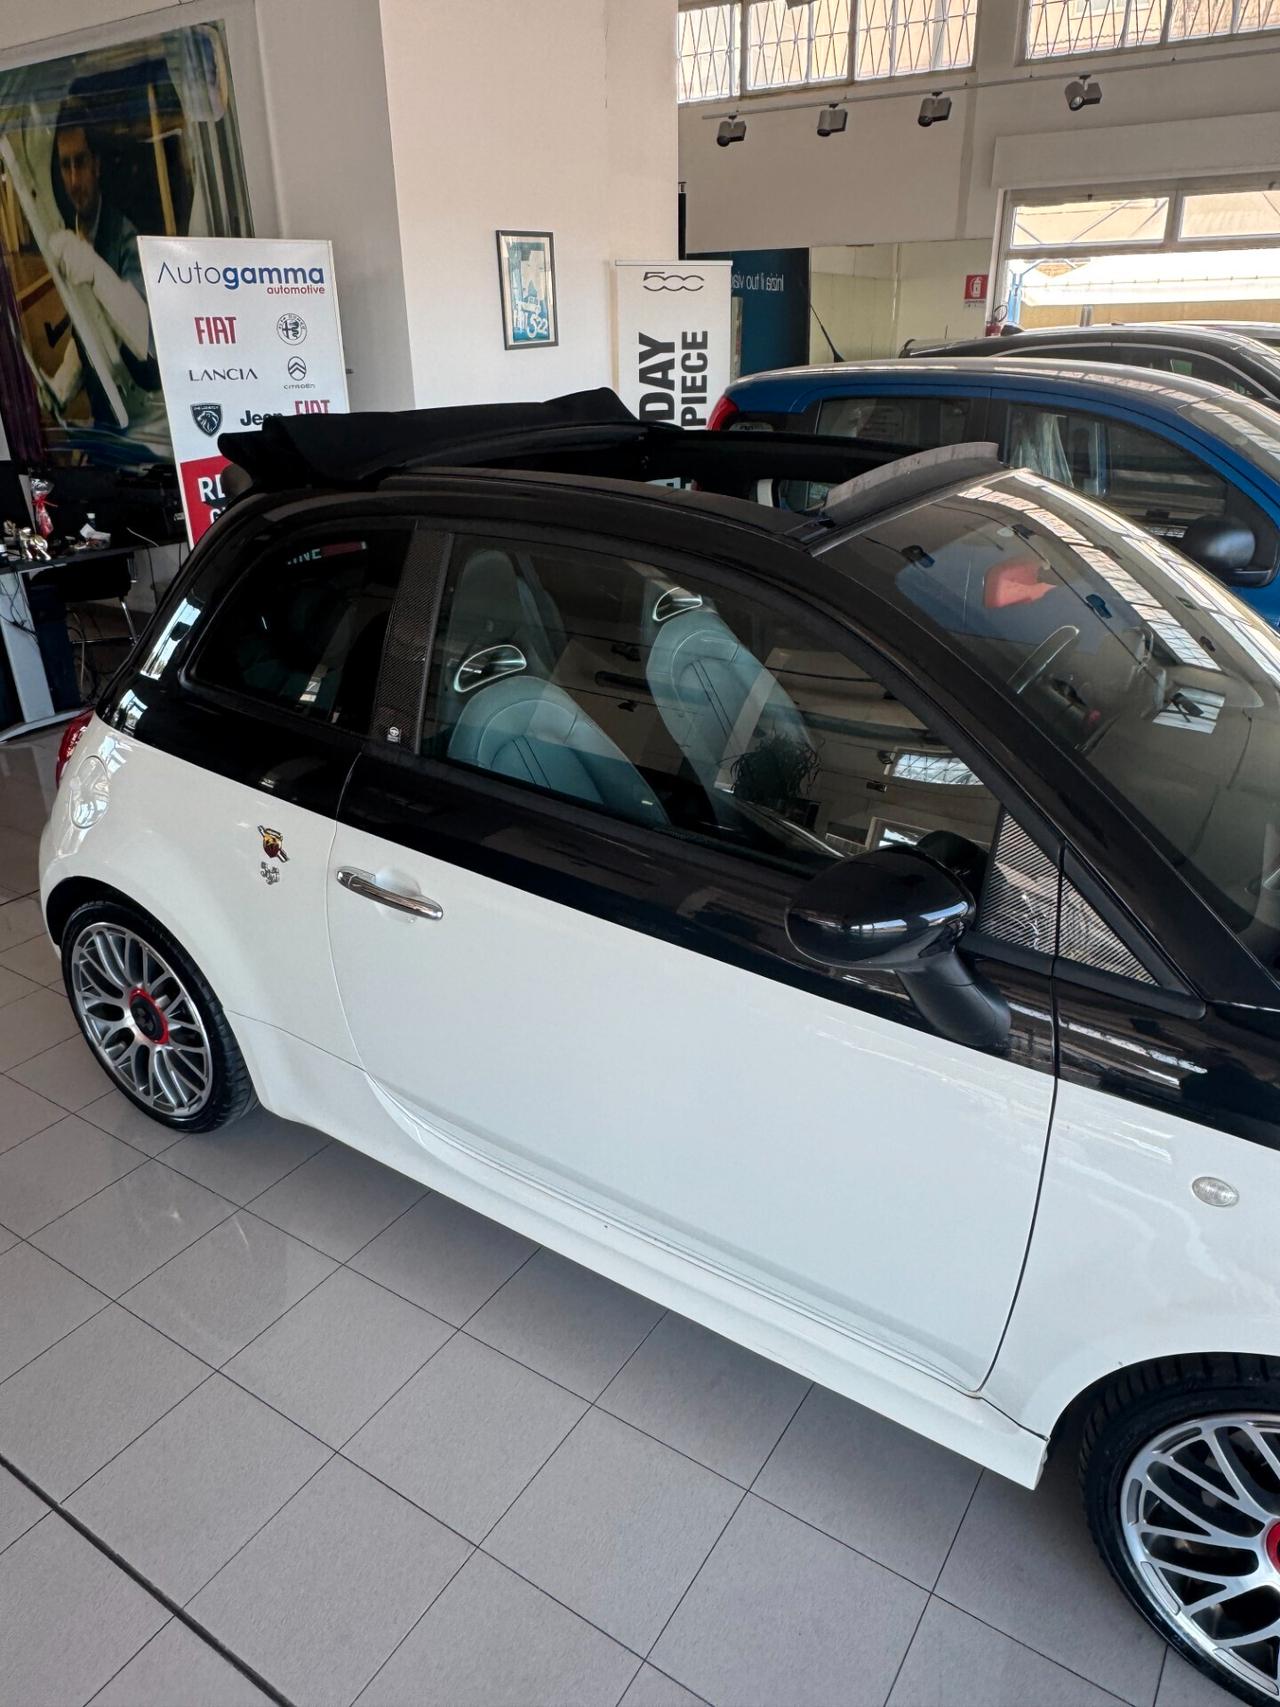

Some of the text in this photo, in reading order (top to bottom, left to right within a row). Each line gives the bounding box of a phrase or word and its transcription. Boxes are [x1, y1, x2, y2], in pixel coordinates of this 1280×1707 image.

[157, 261, 325, 290] Autogamma
[266, 284, 326, 295] automotive
[194, 316, 237, 345] FIAT
[188, 368, 259, 382] LANCIA
[680, 330, 709, 427] PIECE
[239, 409, 283, 427] Je
